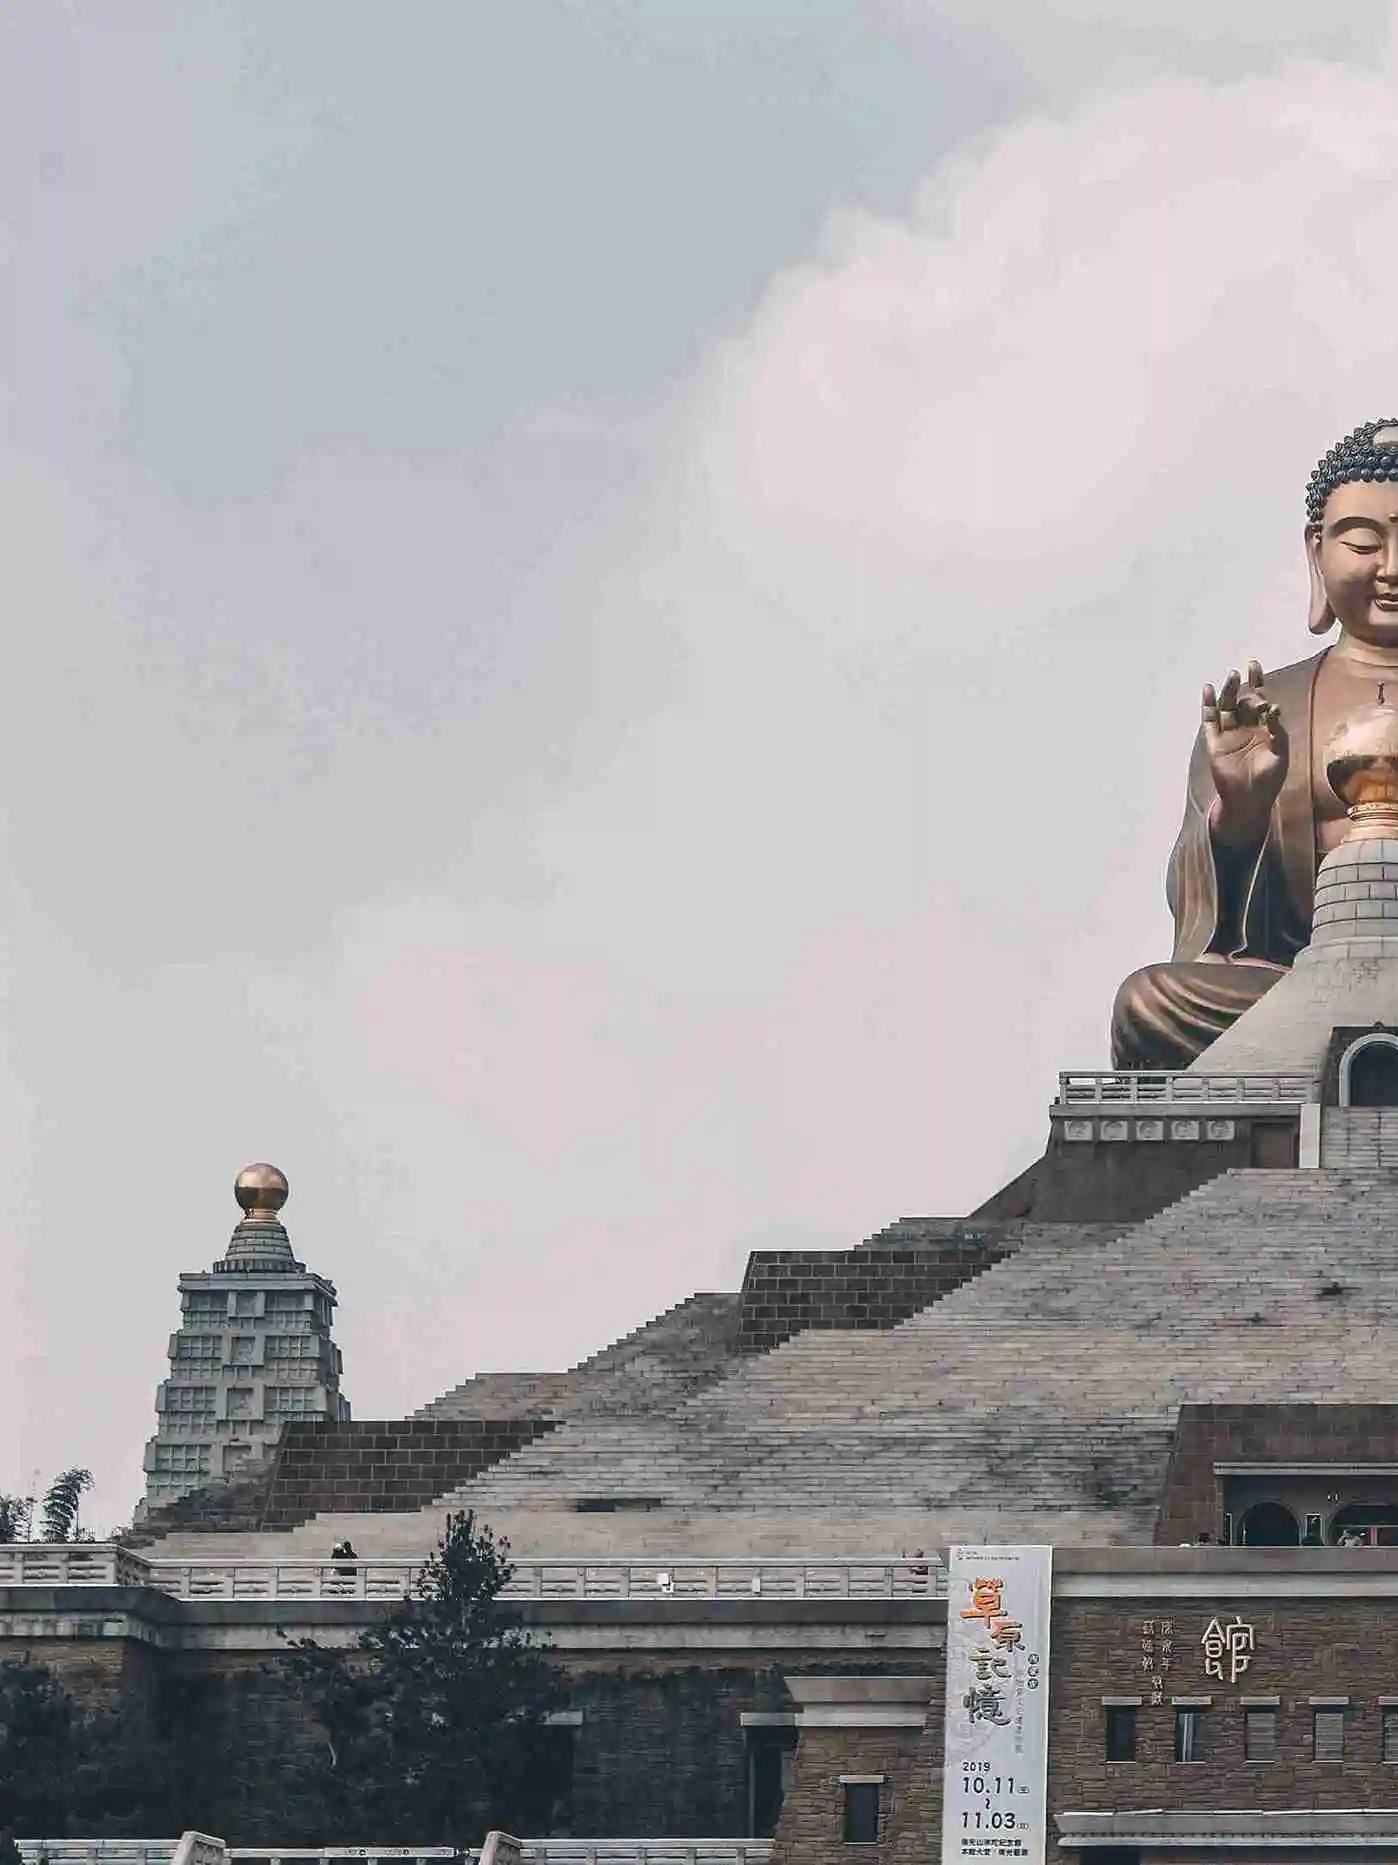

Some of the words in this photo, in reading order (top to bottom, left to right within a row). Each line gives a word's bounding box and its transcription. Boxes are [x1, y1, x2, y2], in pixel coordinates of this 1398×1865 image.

[960, 1578, 1025, 1726] 草原記憶
[962, 1762, 991, 1772] 2019
